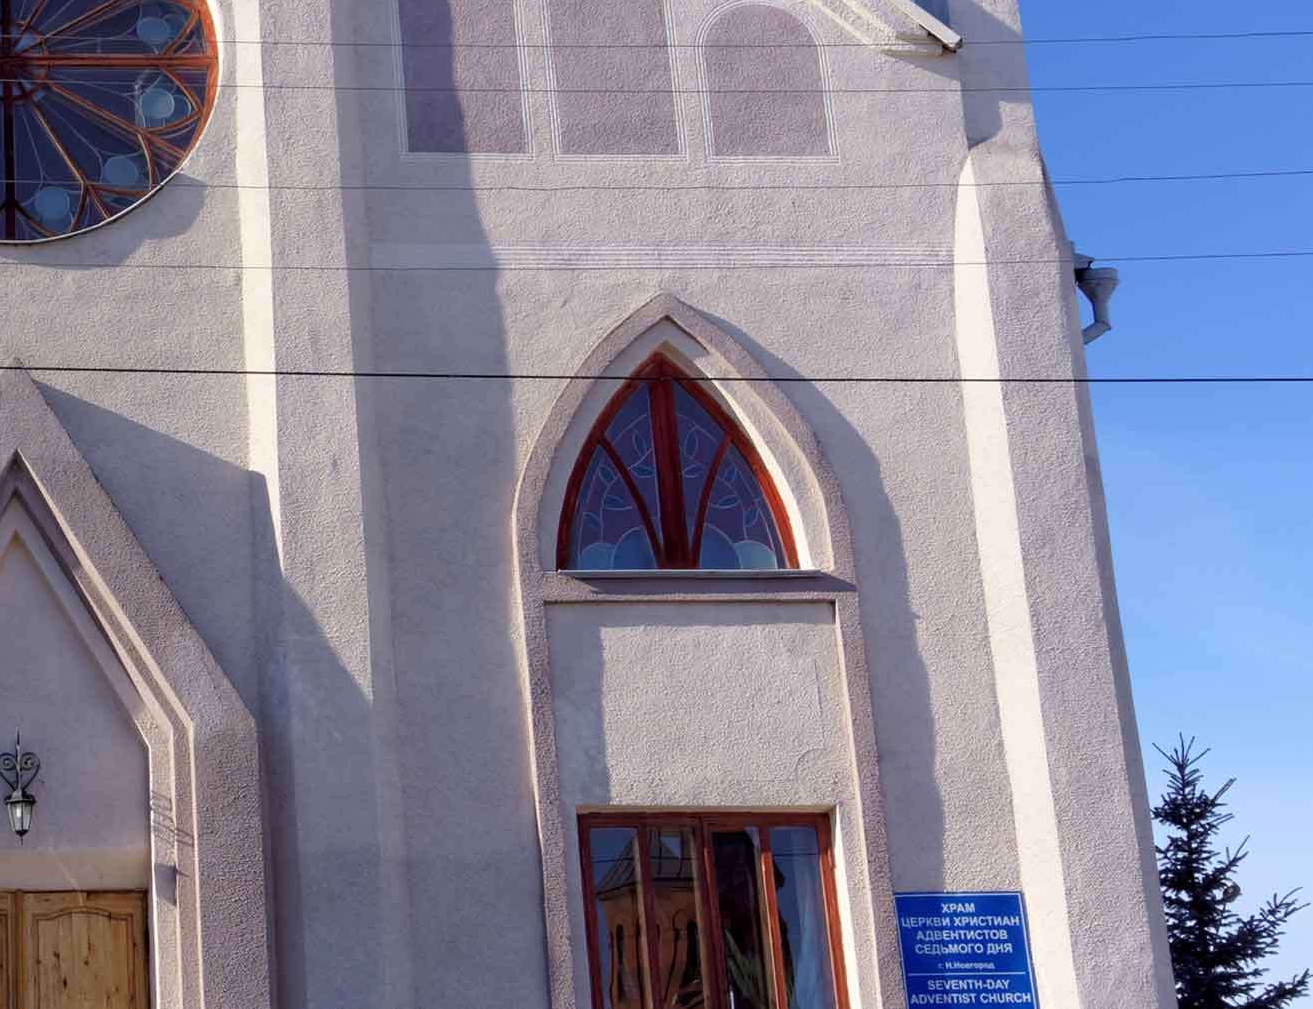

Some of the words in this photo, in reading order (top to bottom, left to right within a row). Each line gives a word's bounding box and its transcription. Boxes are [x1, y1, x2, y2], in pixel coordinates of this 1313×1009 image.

[941, 902, 975, 913] ХРАМ
[901, 917, 951, 929] ЦЕРКВИ
[953, 916, 1020, 927] ХРИСТИАН
[916, 929, 1008, 942] АДВЕНТИСТОВ
[915, 943, 984, 956] СЕДЬМОГО
[987, 942, 1013, 955] ДНЯ
[927, 979, 1010, 991] SEVENTH-DAY
[910, 993, 977, 1005] ADVENTIST
[981, 992, 1032, 1004] CHURCH
